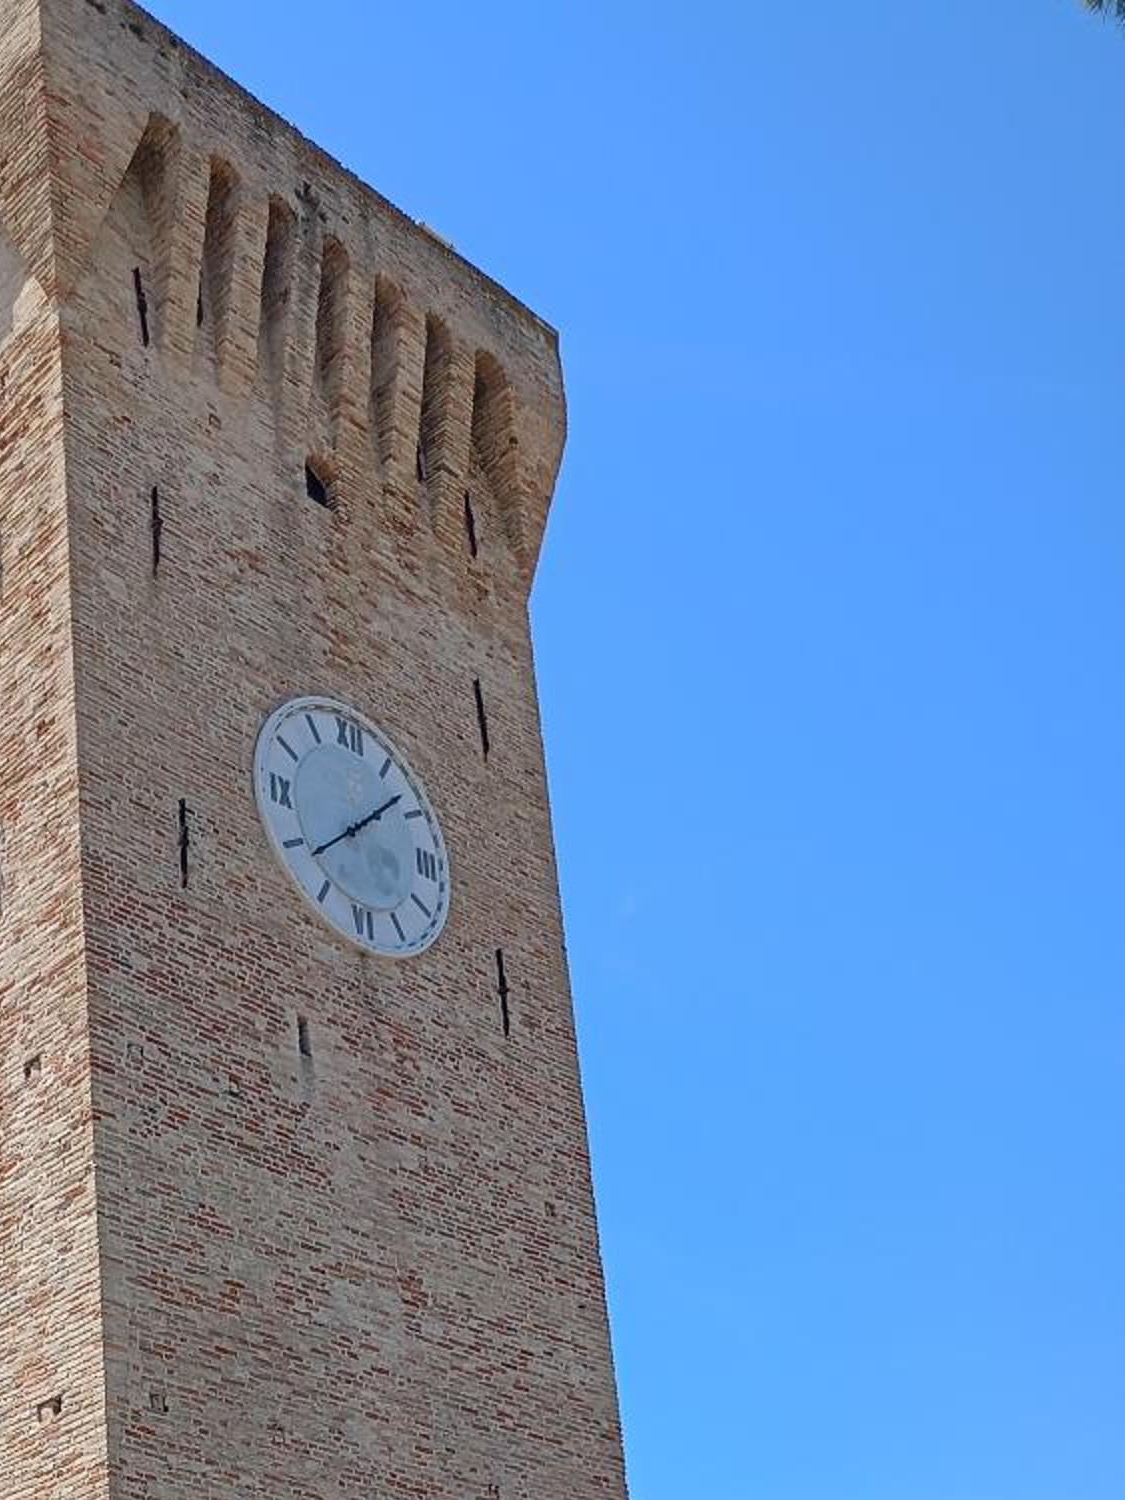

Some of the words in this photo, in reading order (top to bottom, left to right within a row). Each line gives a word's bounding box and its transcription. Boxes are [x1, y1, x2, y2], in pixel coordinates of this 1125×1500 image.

[335, 716, 364, 757] XII
[269, 771, 293, 810] IX
[416, 847, 437, 882] III
[352, 904, 374, 941] VI
